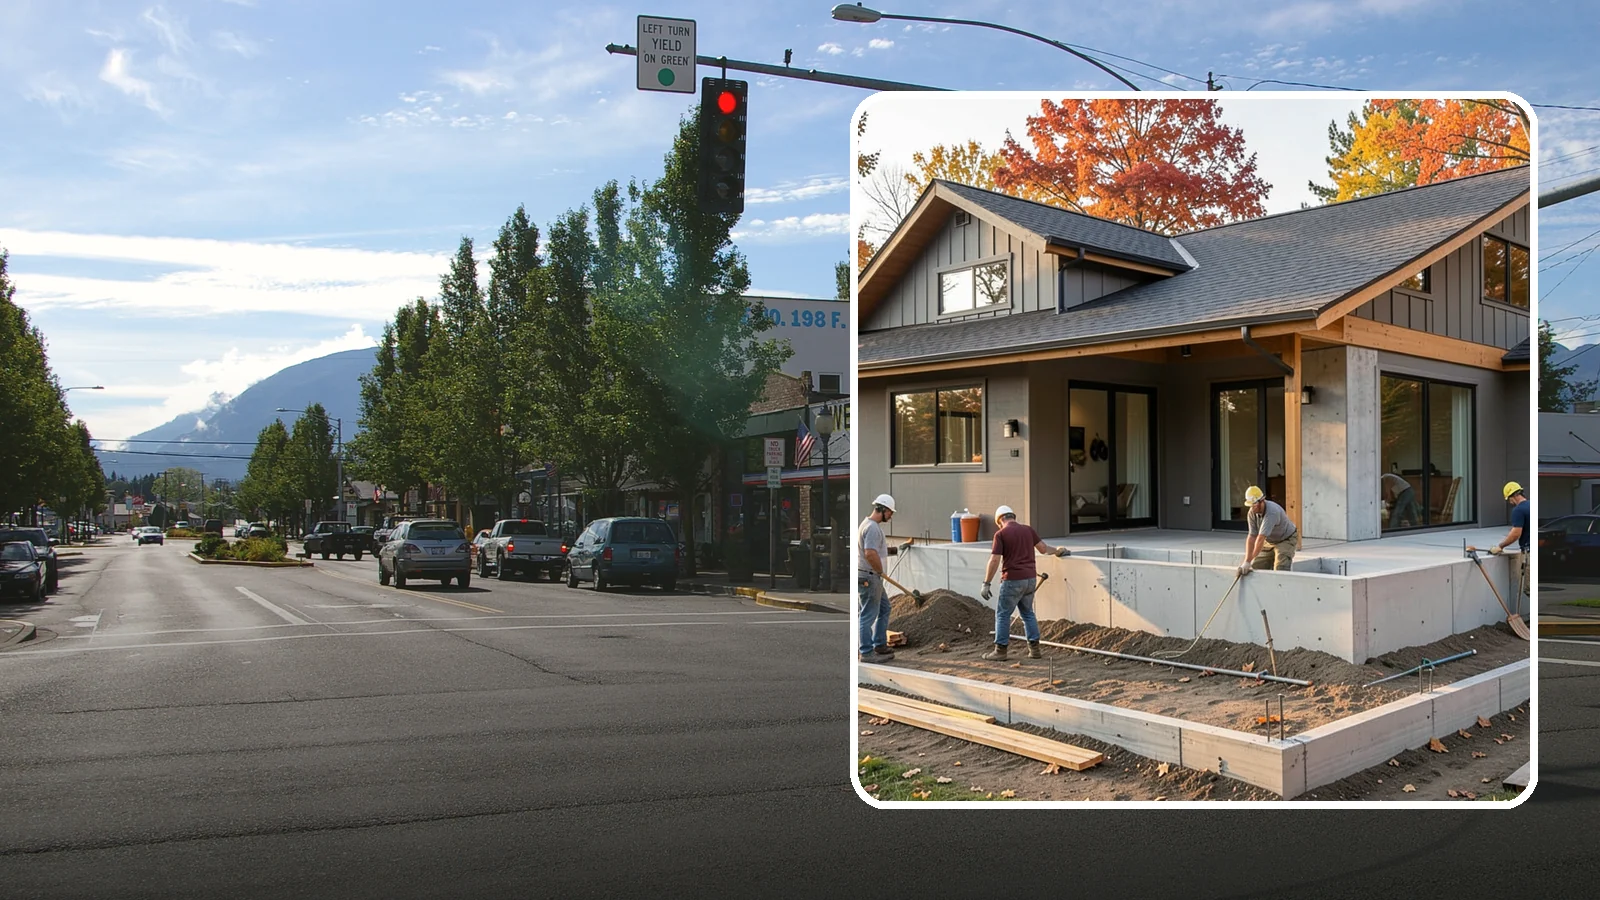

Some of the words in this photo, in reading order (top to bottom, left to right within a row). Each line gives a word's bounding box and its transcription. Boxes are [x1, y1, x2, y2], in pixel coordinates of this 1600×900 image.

[642, 23, 663, 34] LEFT
[668, 26, 690, 36] TURN
[652, 38, 682, 51] YIELD
[791, 309, 826, 328] 198
[831, 311, 847, 329] F.
